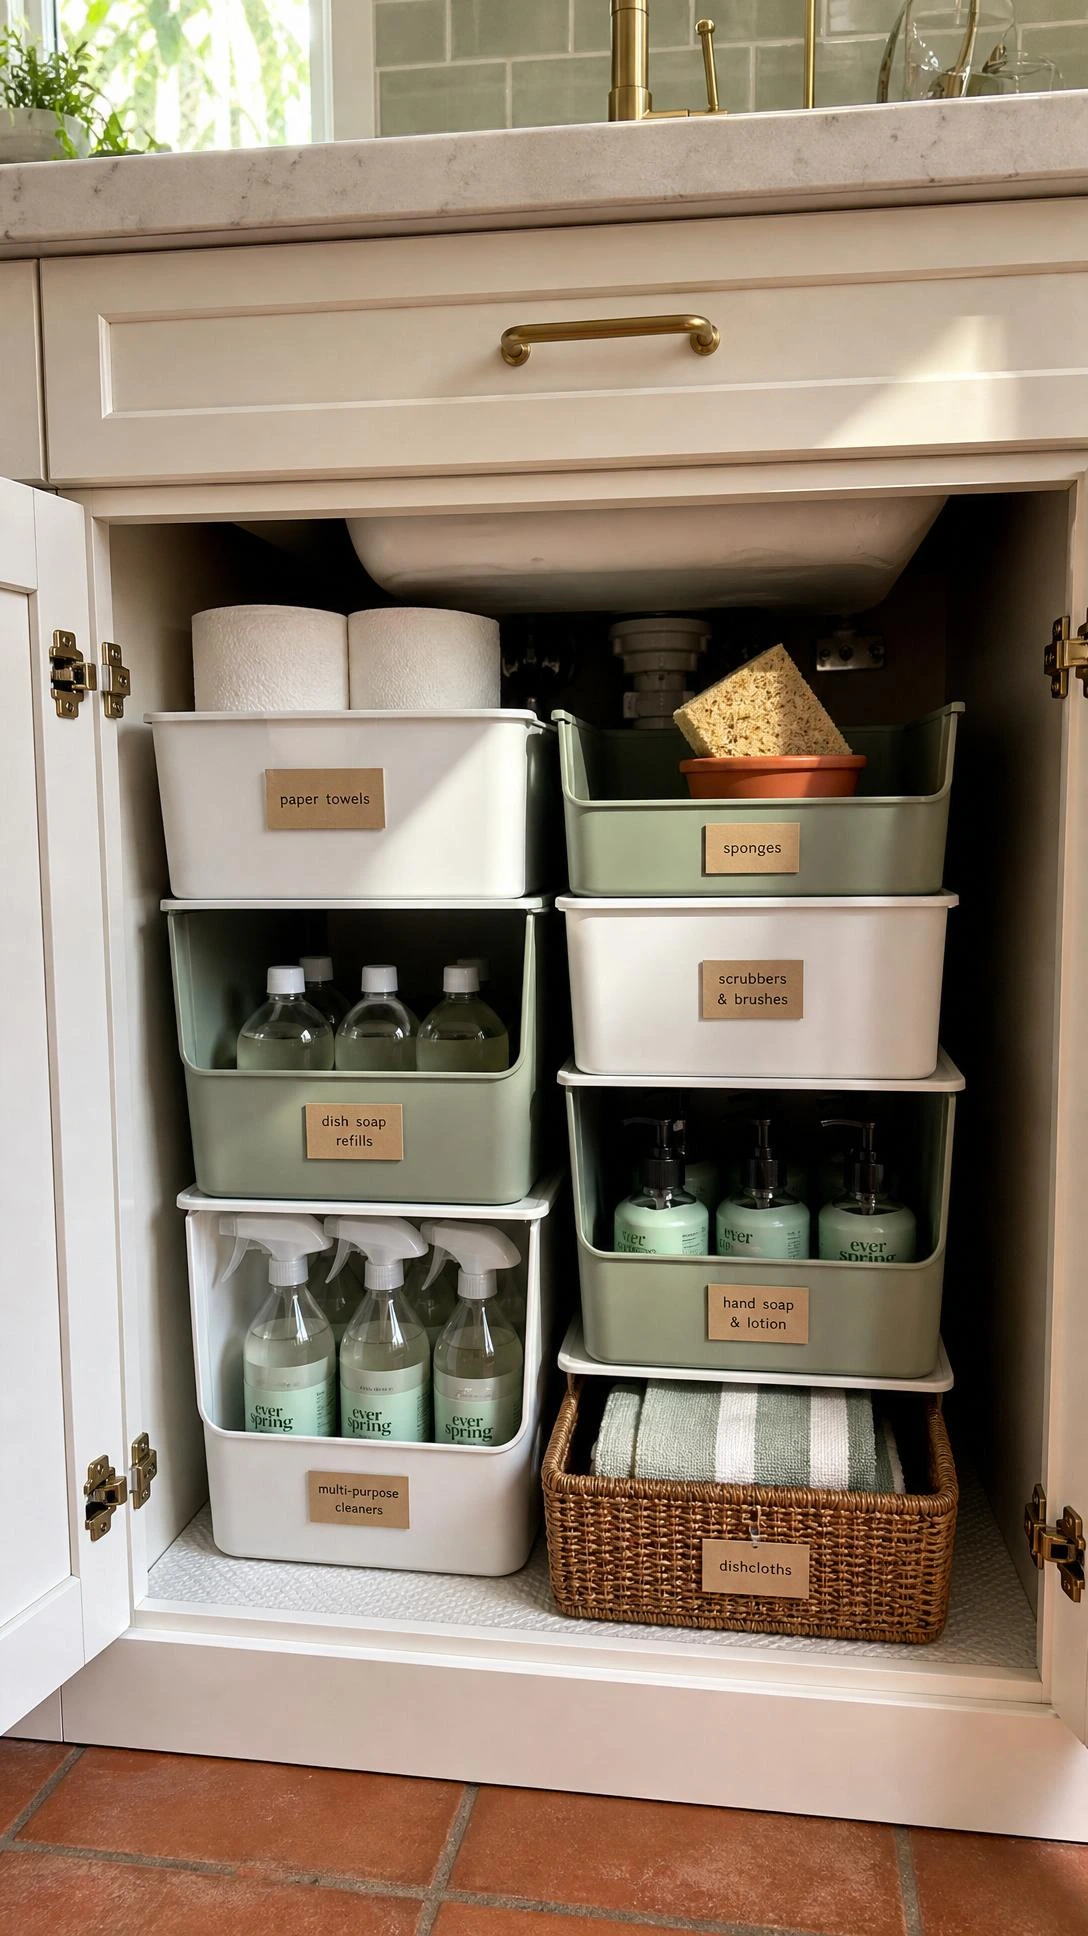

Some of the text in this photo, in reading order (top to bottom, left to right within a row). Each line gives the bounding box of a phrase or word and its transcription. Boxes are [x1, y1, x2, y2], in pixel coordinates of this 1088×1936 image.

[280, 791, 370, 809] paper towels
[723, 843, 782, 857] sponges
[718, 971, 787, 985] scrubbers
[717, 992, 788, 1006] & brushes
[321, 1114, 387, 1131] dish soap
[336, 1134, 374, 1147] refills
[850, 1240, 887, 1253] ever
[723, 1295, 795, 1315] hand soap
[730, 1315, 787, 1331] & lotion
[255, 1404, 283, 1417] ever
[352, 1408, 382, 1421] ever
[250, 1412, 294, 1432] spring
[347, 1417, 392, 1437] spring
[452, 1415, 484, 1428] ever
[445, 1424, 494, 1442] spring
[318, 1483, 399, 1500] multi-purpose
[335, 1501, 384, 1516] cleaners
[719, 1559, 792, 1576] dishcloths
